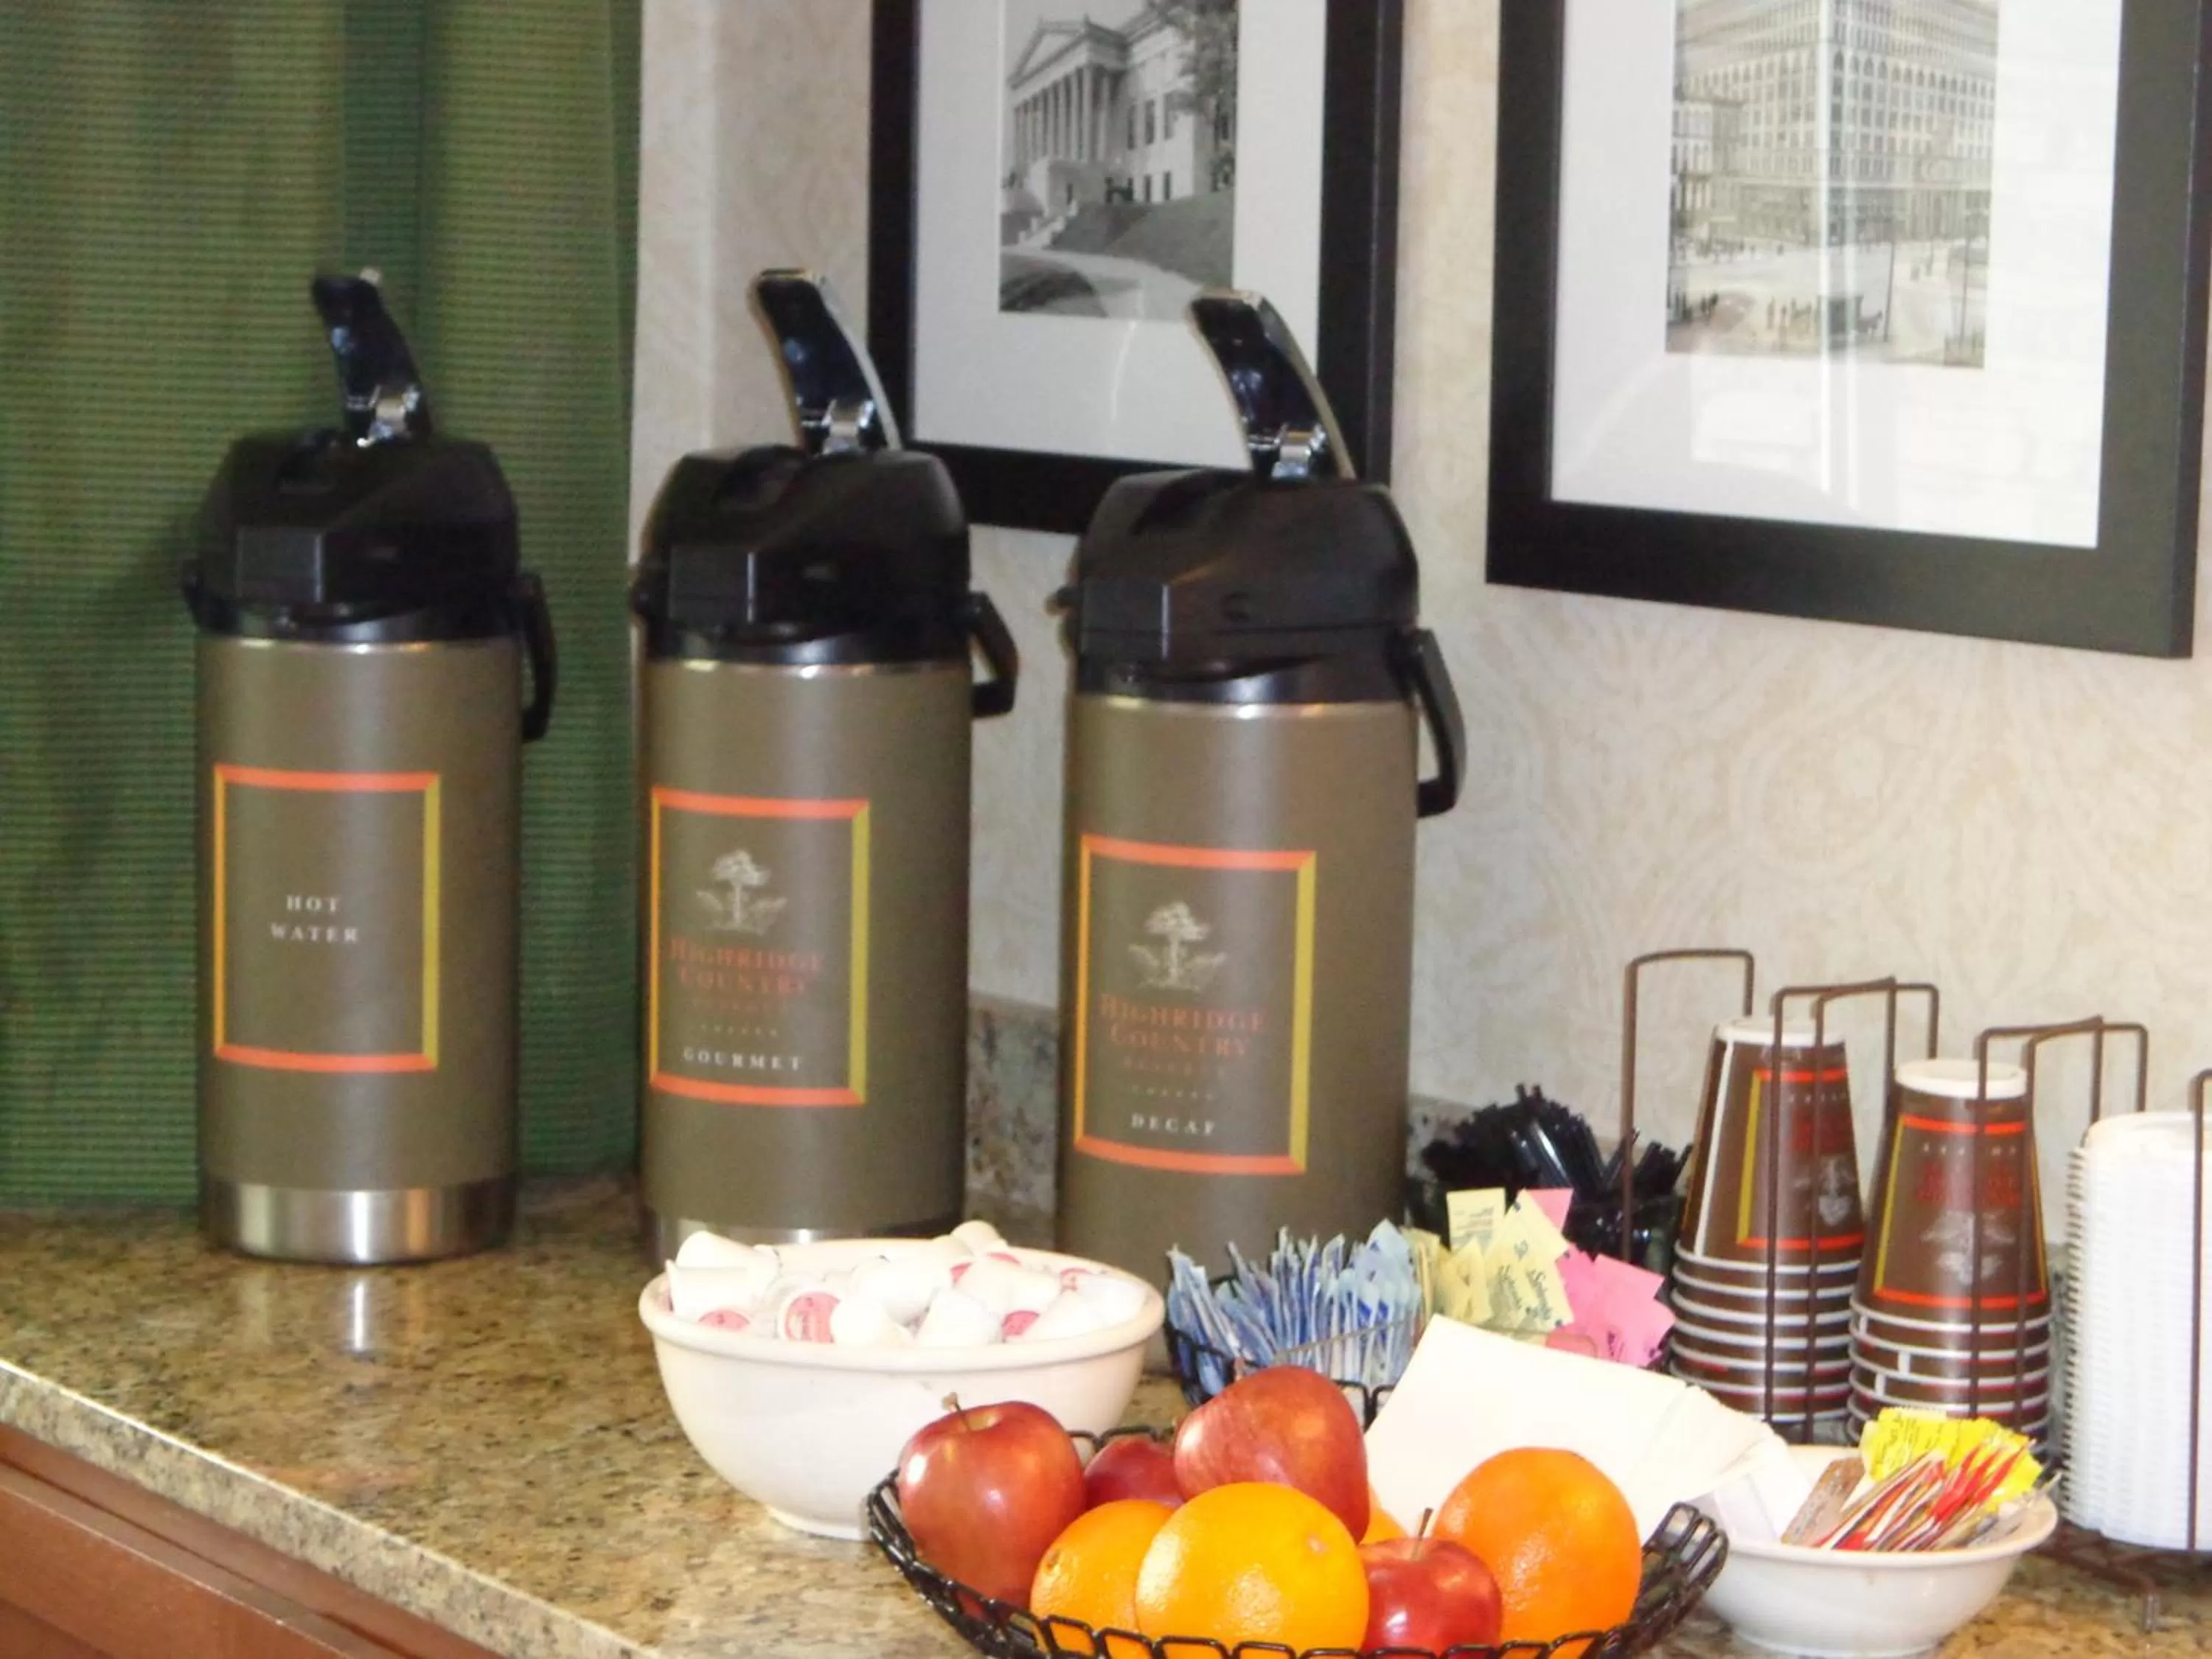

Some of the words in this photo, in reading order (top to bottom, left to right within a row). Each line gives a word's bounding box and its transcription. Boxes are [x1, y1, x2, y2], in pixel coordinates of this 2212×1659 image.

[286, 894, 341, 913] HOT
[270, 922, 359, 944] WATER
[683, 1046, 803, 1071] GOURMET
[1130, 1112, 1217, 1136] DECAF
